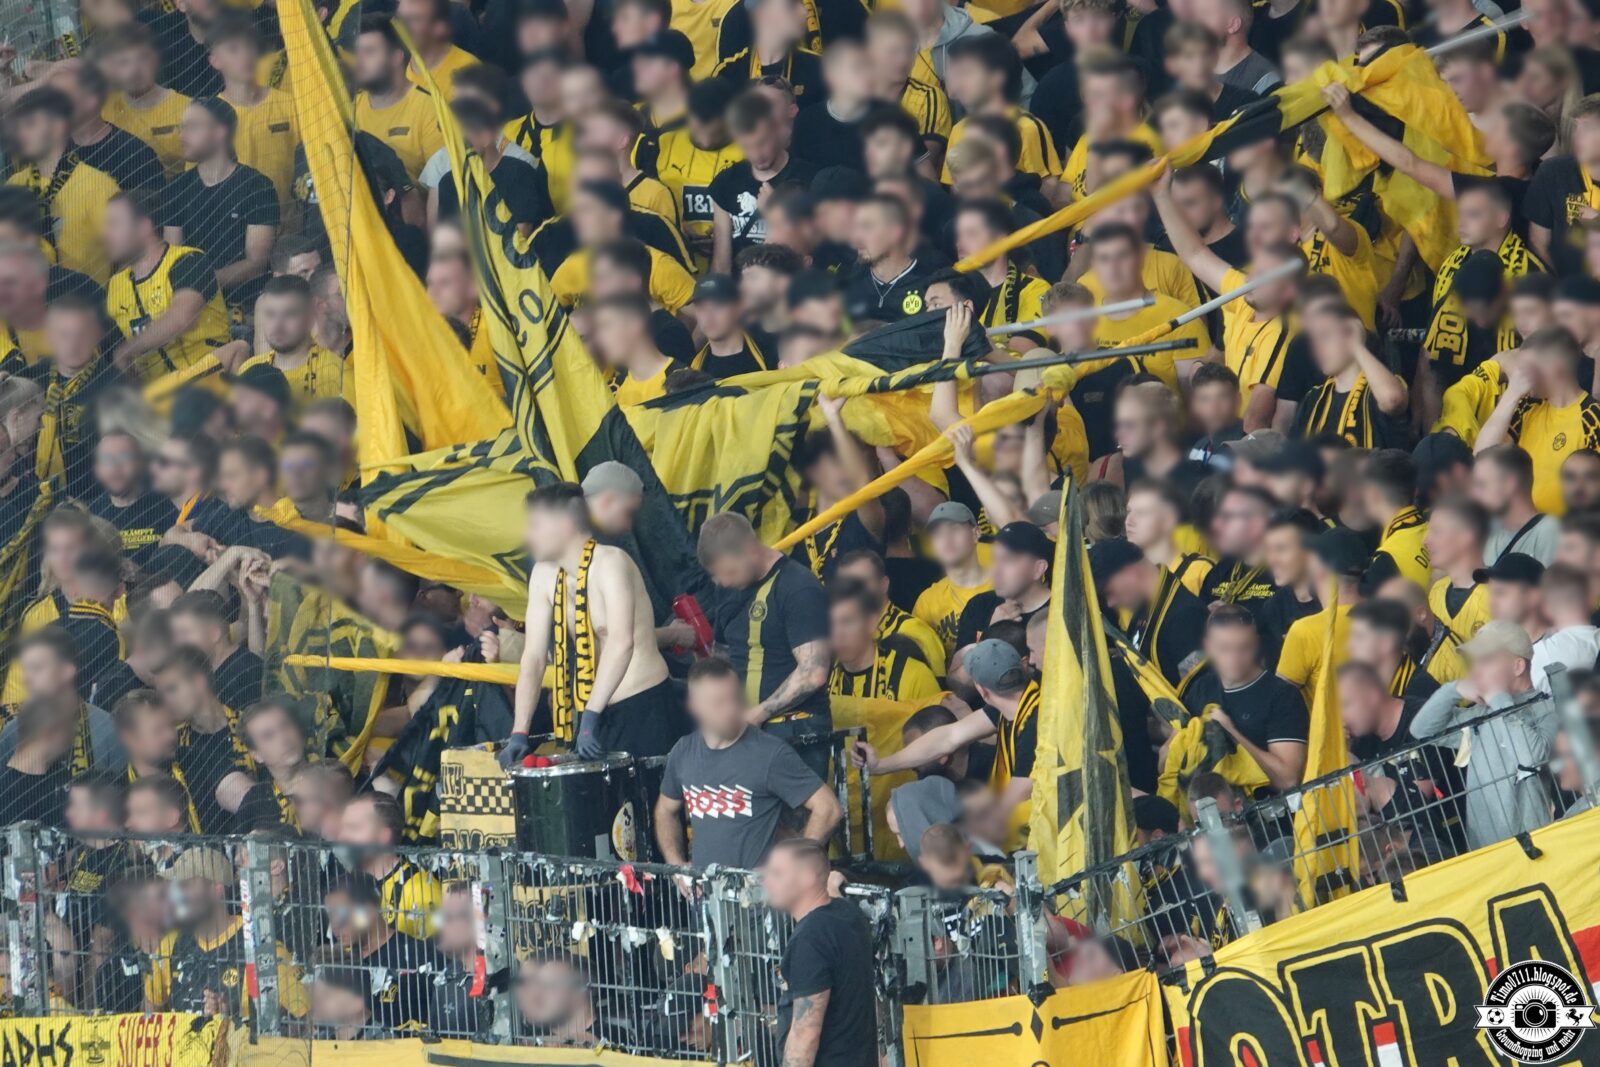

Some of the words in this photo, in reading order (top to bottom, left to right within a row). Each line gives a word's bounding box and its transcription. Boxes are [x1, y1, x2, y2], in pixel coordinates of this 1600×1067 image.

[685, 194, 714, 213] 1&1
[905, 296, 920, 309] BVB
[683, 789, 746, 814] BOSS
